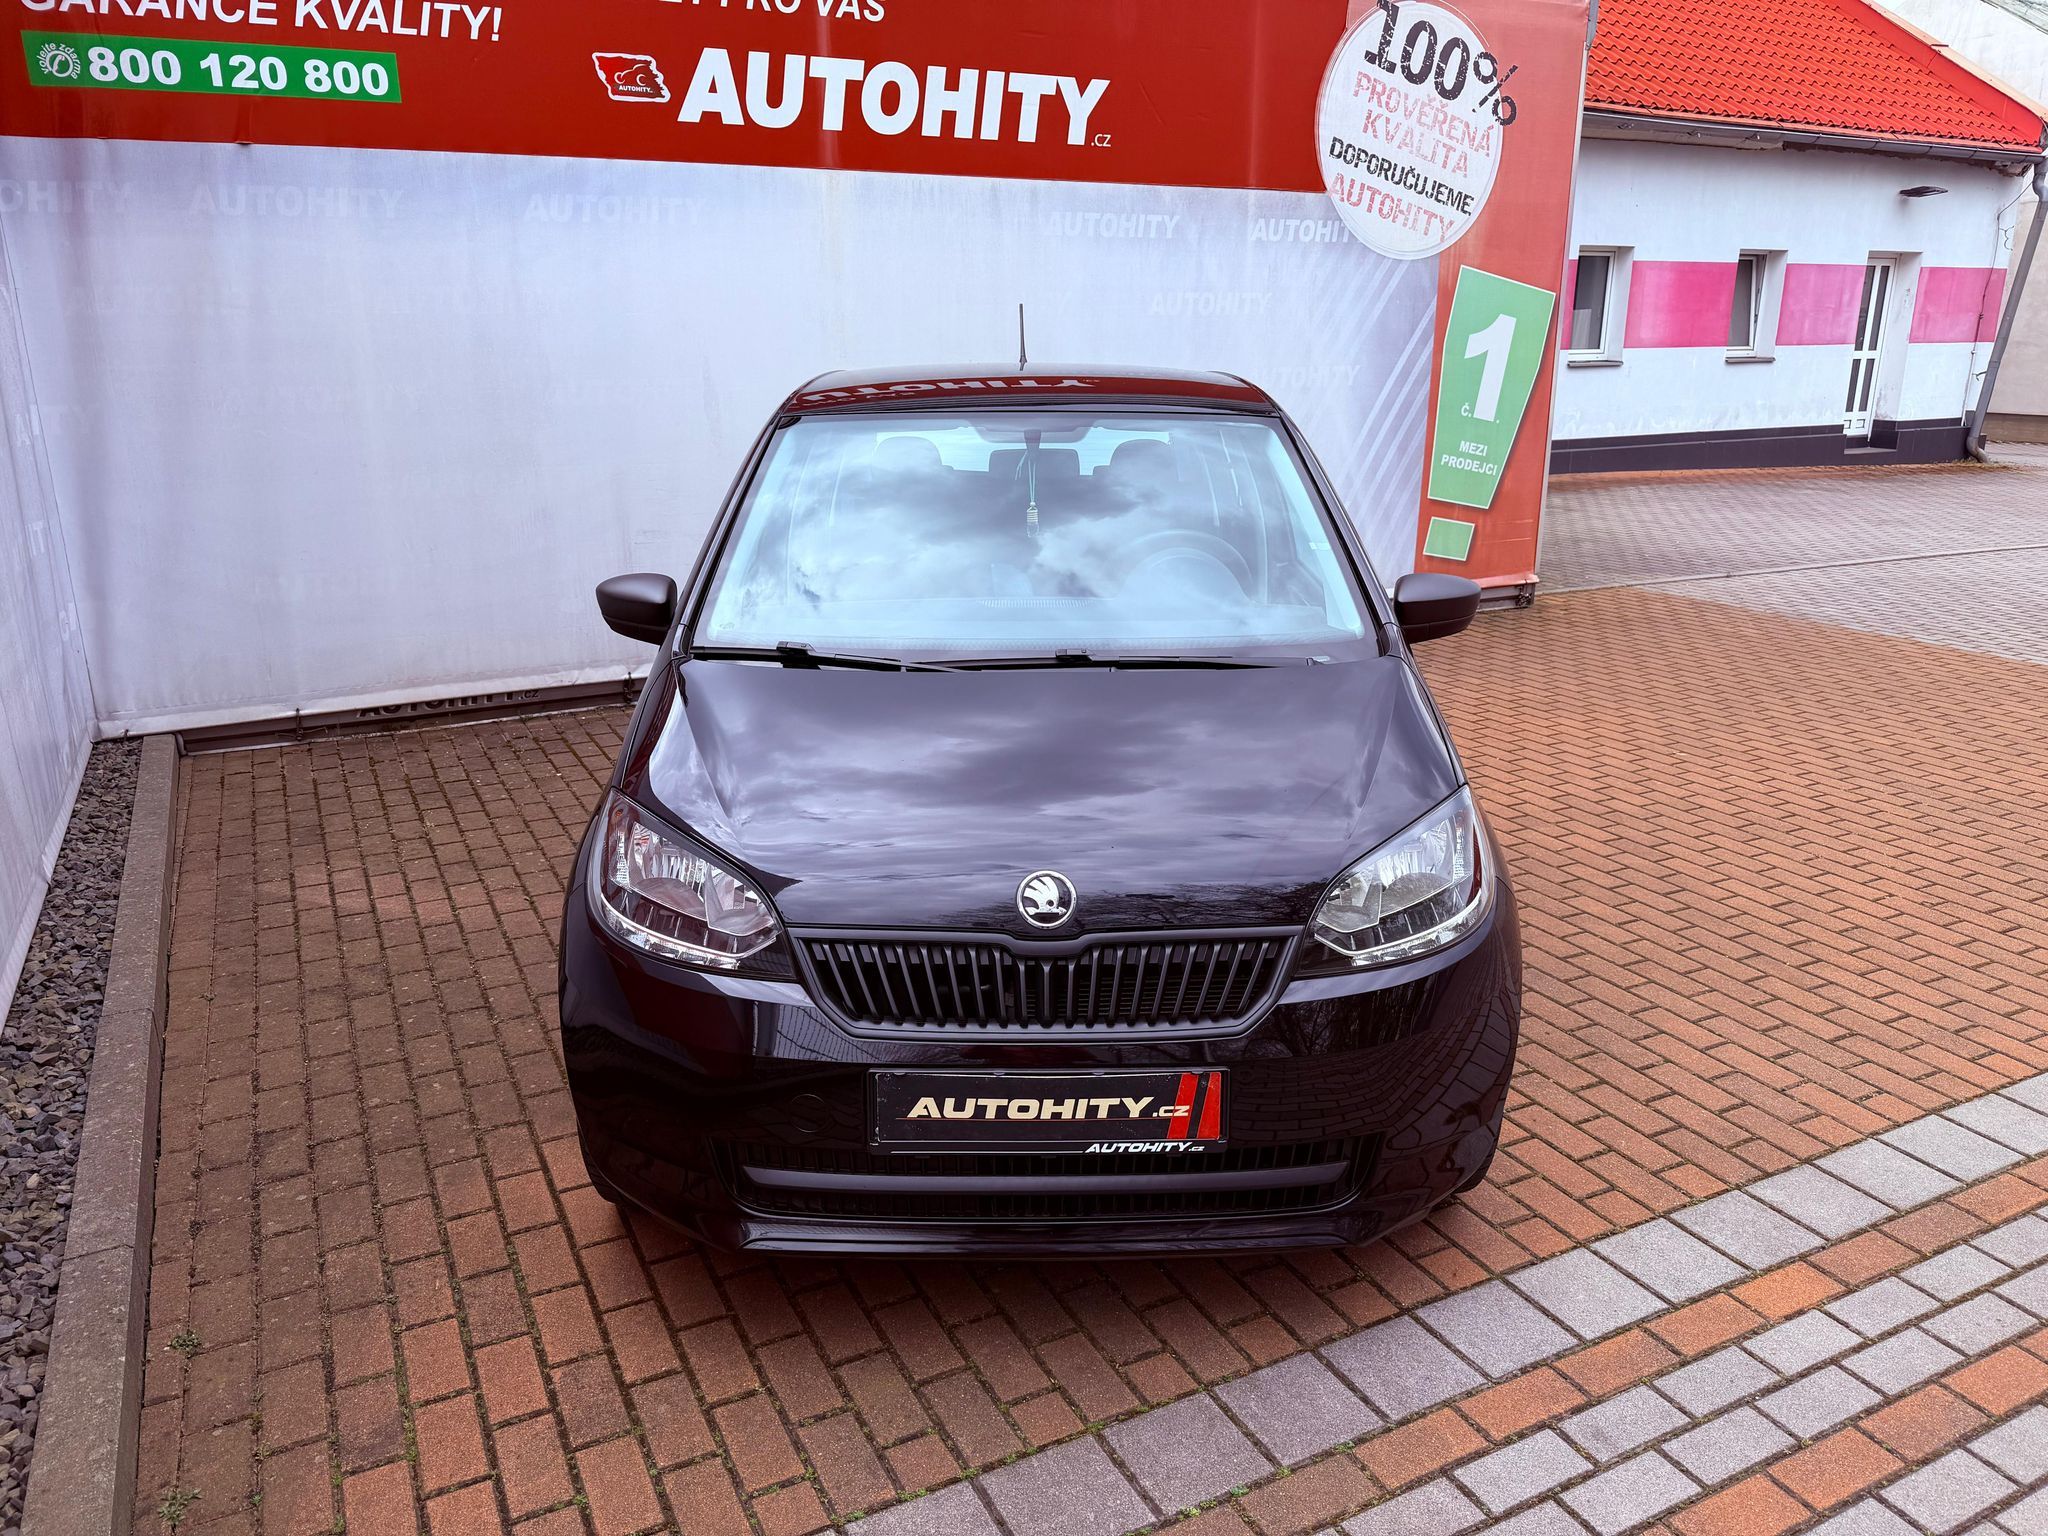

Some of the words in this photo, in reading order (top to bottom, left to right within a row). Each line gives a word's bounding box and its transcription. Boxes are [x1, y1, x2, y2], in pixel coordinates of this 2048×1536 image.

[294, 0, 503, 42] KVALITY!
[36, 42, 57, 74] volejte
[58, 43, 81, 80] zdarma
[87, 46, 182, 85] 800
[199, 51, 288, 91] 120
[303, 57, 390, 96] 800
[1363, 0, 1518, 126] 100%
[1352, 71, 1496, 158] PROVĚŘENÁ
[1361, 109, 1469, 178] KVALITA
[1328, 136, 1475, 216] DOPORUČUJEME
[188, 183, 403, 217] AUTOHITY
[523, 193, 704, 225] AUTOHITY
[1326, 172, 1456, 243] AUTOHITY
[1044, 211, 1181, 239] AUTOHITY
[1148, 292, 1272, 316] AUTOHITY
[1440, 454, 1499, 476] PRODEJCI
[1459, 440, 1488, 457] MEZI
